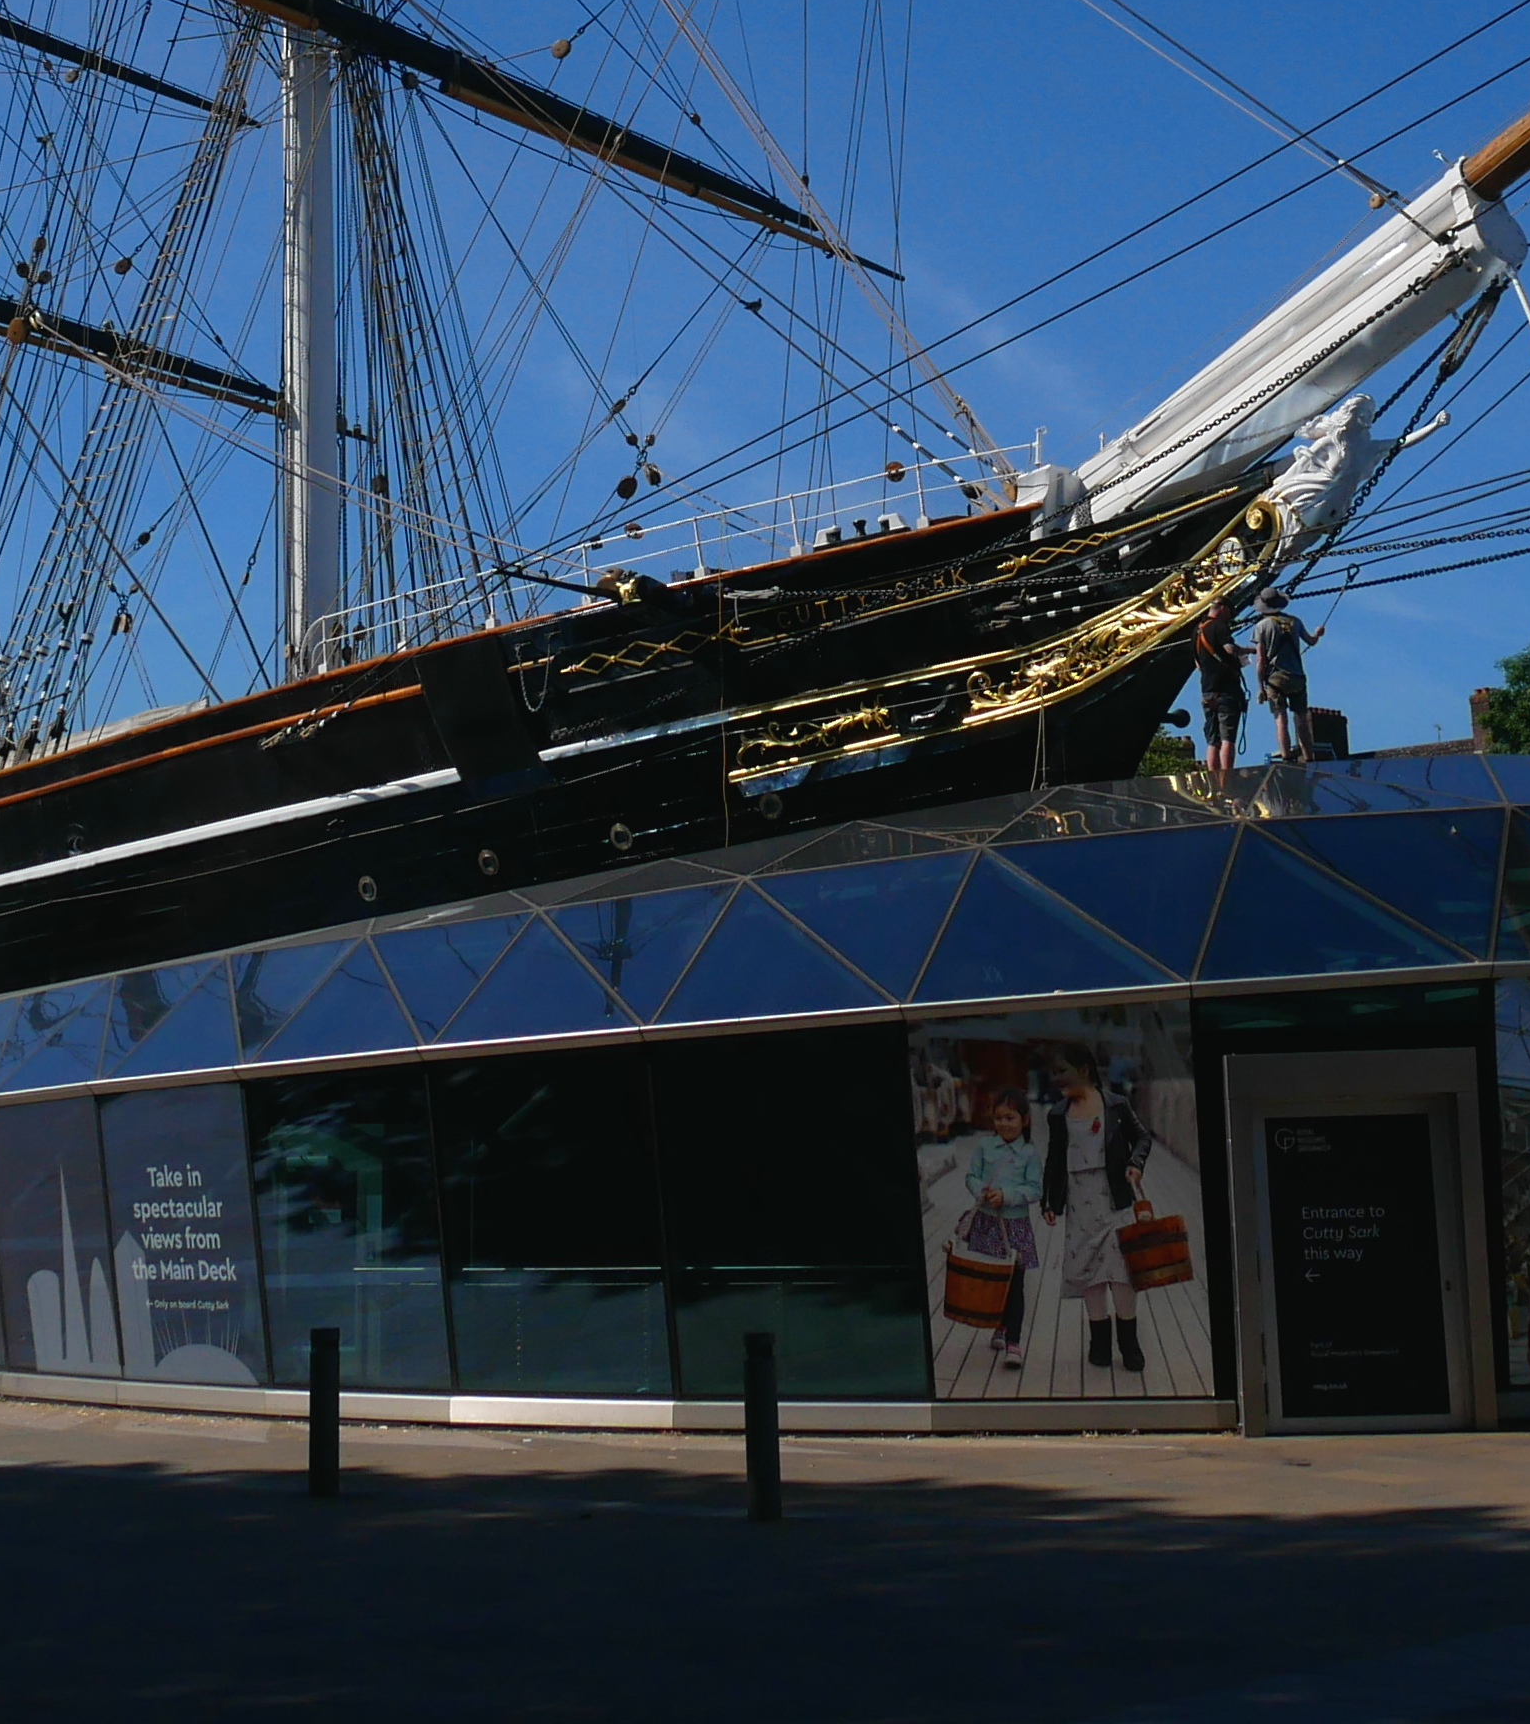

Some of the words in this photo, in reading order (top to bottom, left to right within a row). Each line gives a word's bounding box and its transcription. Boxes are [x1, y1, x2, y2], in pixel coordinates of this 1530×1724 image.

[777, 594, 866, 629] CUTTY
[146, 1164, 183, 1188] Take
[186, 1163, 202, 1187] in
[133, 1194, 223, 1223] spectacular
[1301, 1206, 1365, 1219] Entrance
[1369, 1206, 1385, 1218] to
[141, 1226, 183, 1250] views
[185, 1225, 221, 1250] from
[1303, 1226, 1343, 1242] Cutty
[1348, 1224, 1380, 1238] Sark
[1304, 1246, 1330, 1260] this
[1333, 1247, 1364, 1262] way
[132, 1257, 157, 1280] the
[160, 1257, 195, 1281] Main
[198, 1257, 237, 1282] Deck
[154, 1298, 168, 1310] Only
[178, 1298, 197, 1309] board
[197, 1299, 215, 1312] Cutty
